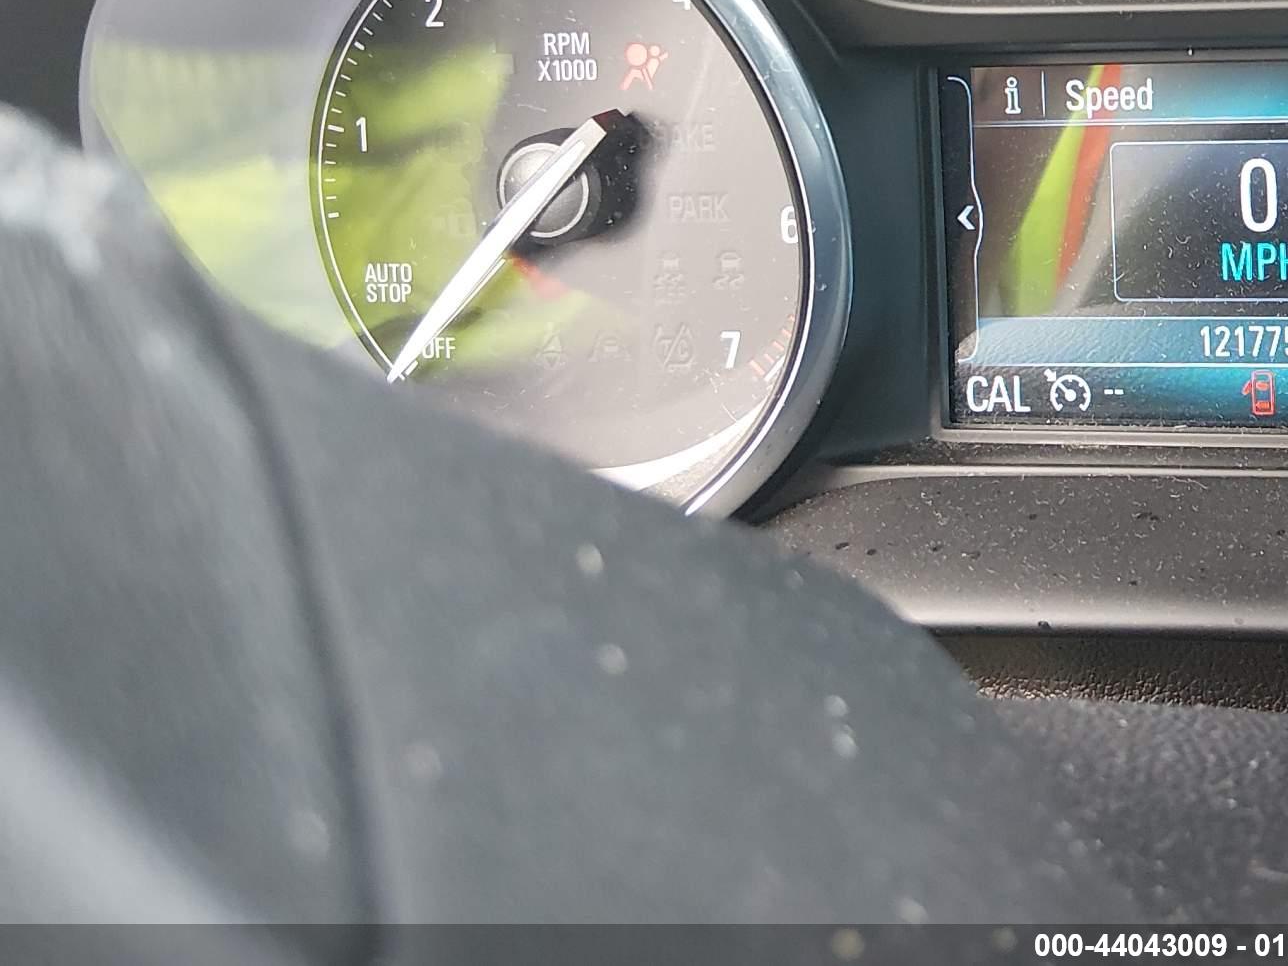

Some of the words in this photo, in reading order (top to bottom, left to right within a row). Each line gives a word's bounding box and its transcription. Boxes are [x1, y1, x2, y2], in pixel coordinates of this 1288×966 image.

[543, 31, 590, 56] RPM
[537, 57, 598, 82] X1000
[1065, 78, 1154, 117] Speed
[355, 116, 368, 152] 1
[1239, 157, 1278, 233] 0
[780, 205, 799, 244] 6
[365, 262, 413, 283] AUTO
[366, 283, 412, 303] STOP
[421, 337, 456, 359] OFF
[720, 331, 741, 370] 7
[966, 376, 1030, 413] CAL
